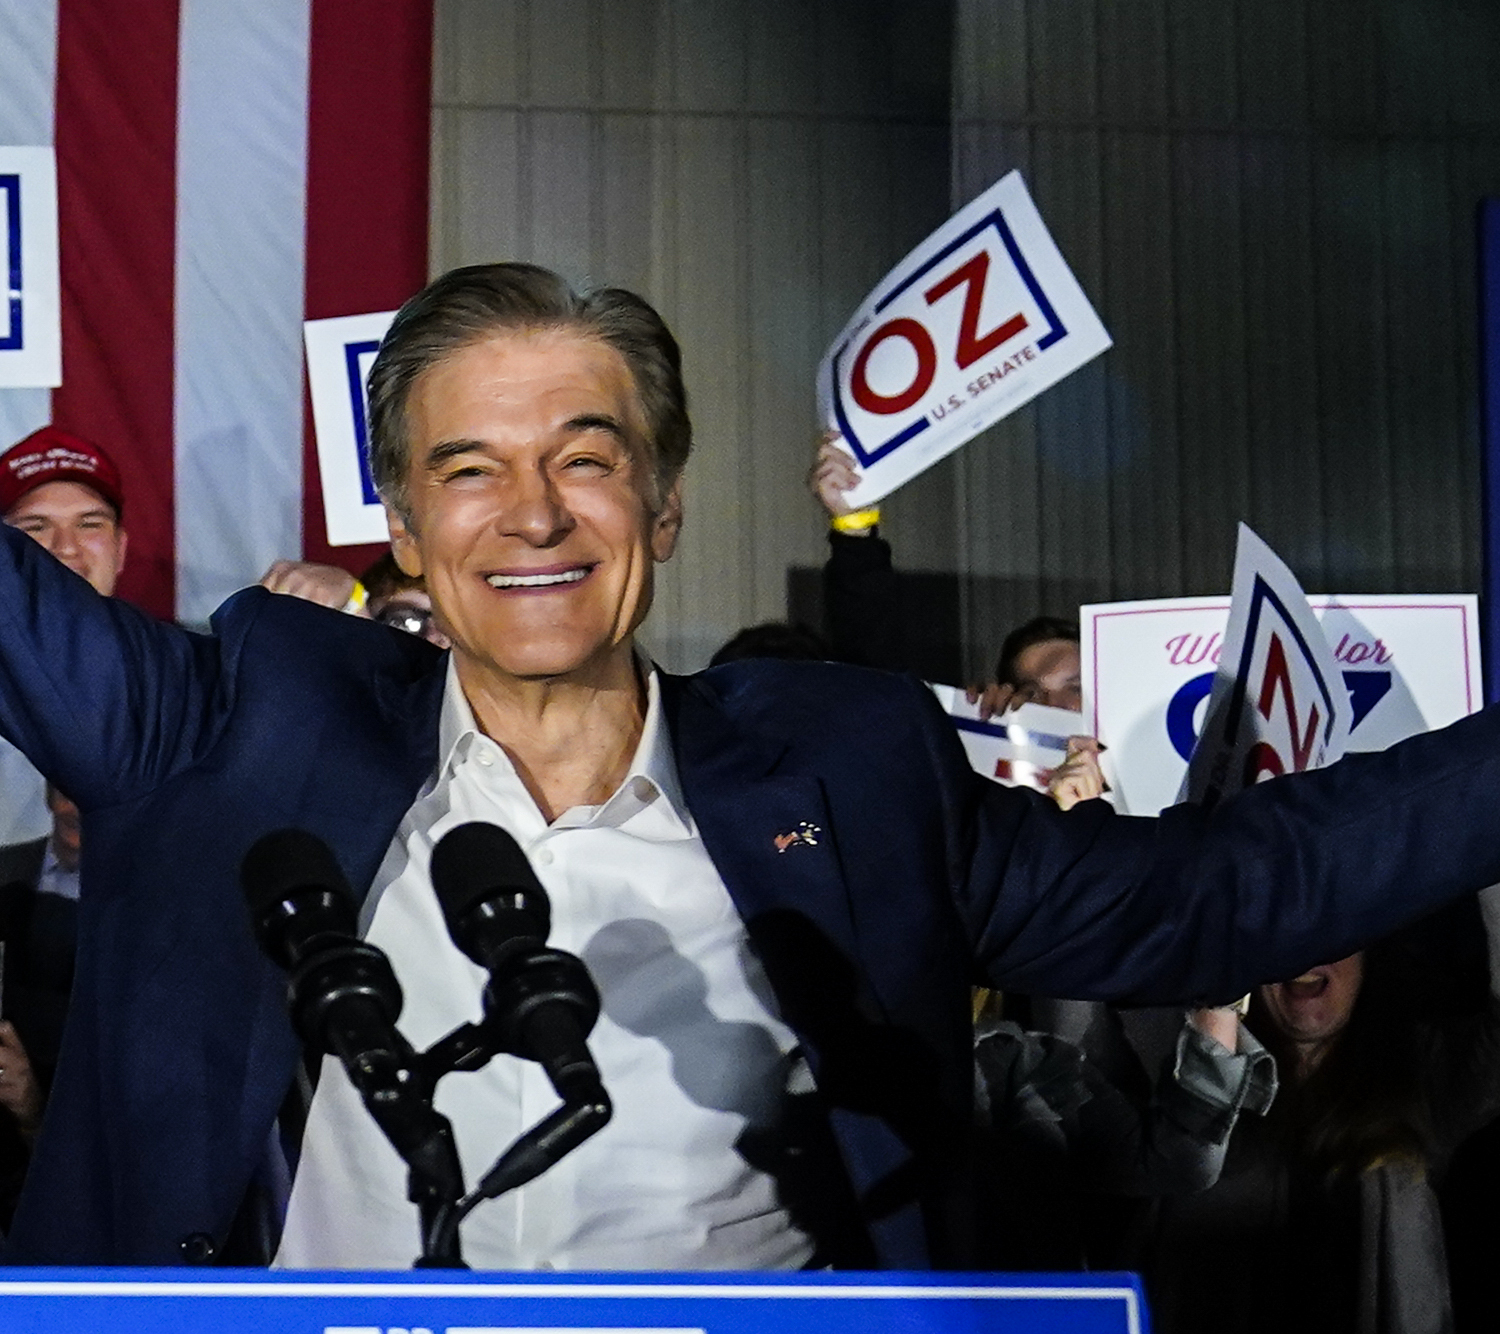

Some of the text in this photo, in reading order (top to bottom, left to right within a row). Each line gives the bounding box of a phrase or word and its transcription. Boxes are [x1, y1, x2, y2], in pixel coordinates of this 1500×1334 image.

[851, 249, 1029, 415] OZ
[930, 344, 1035, 423] U.S. SENATE
